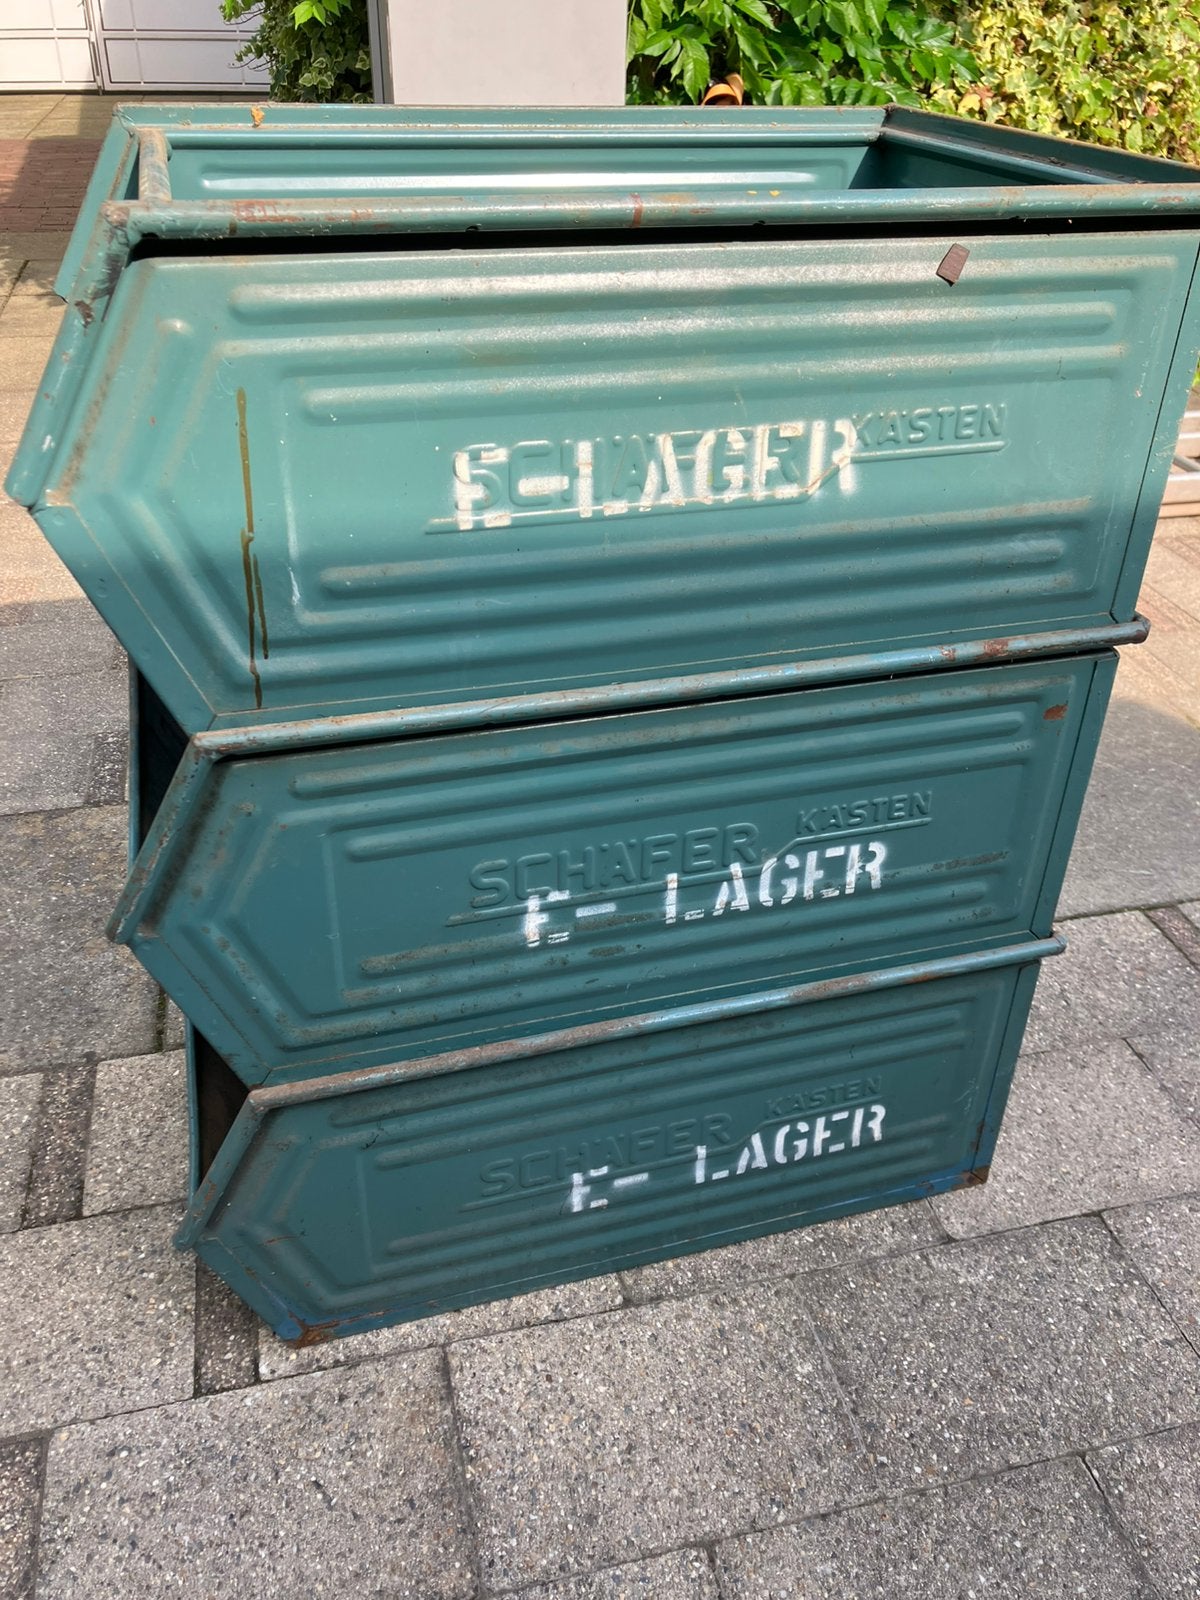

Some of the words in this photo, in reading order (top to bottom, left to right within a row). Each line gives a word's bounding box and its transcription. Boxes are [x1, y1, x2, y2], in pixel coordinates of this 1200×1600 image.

[470, 822, 759, 908] SCHÄFER
[665, 841, 887, 925] LAGER
[479, 1114, 733, 1197] SCHÄFER
[695, 1103, 886, 1184] LAGER
